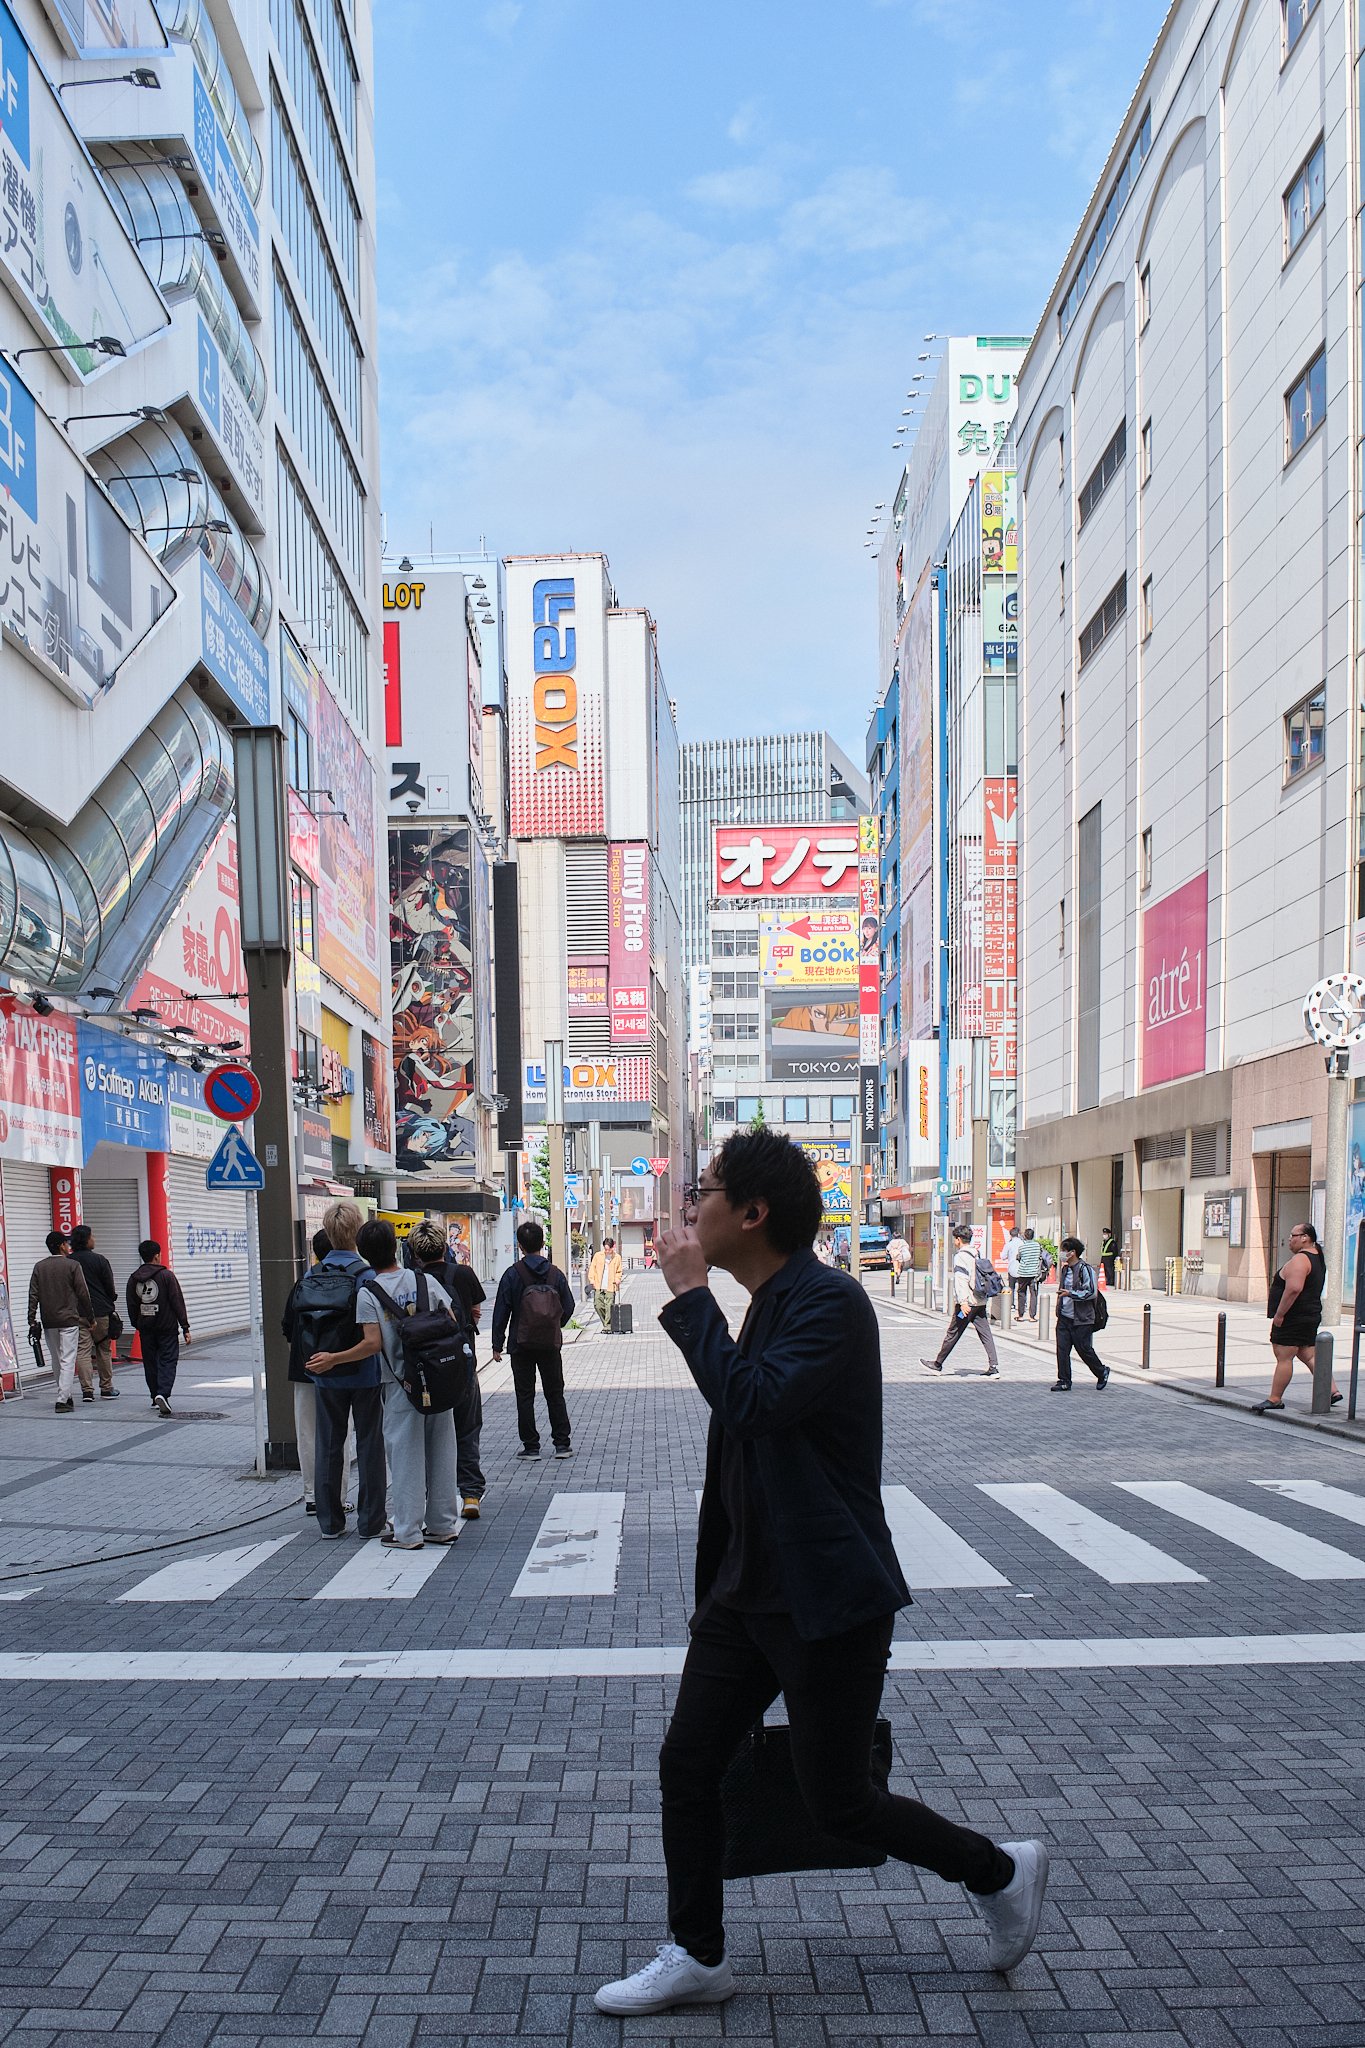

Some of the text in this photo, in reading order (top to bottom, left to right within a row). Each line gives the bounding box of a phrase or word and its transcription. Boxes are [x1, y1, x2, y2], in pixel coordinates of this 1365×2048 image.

[217, 168, 260, 292] 中古専門店
[0, 206, 50, 307] アコン
[959, 373, 1016, 404] DU
[985, 644, 1017, 655] 当ビル
[391, 763, 426, 800] ス
[611, 849, 622, 929] Flagship Store
[621, 849, 647, 953] Duty Free
[800, 948, 855, 963] BOOK
[615, 991, 645, 1006] 免税
[1148, 946, 1191, 1025] atré
[9, 1012, 75, 1065] TAX FREE
[98, 1063, 165, 1106] Sofmap AKIBA
[788, 1062, 841, 1074] TOKYO
[526, 1090, 547, 1099] Hom
[596, 1089, 618, 1098] Store
[866, 1078, 874, 1131] SNKRDUNK
[58, 1197, 73, 1237] INFO
